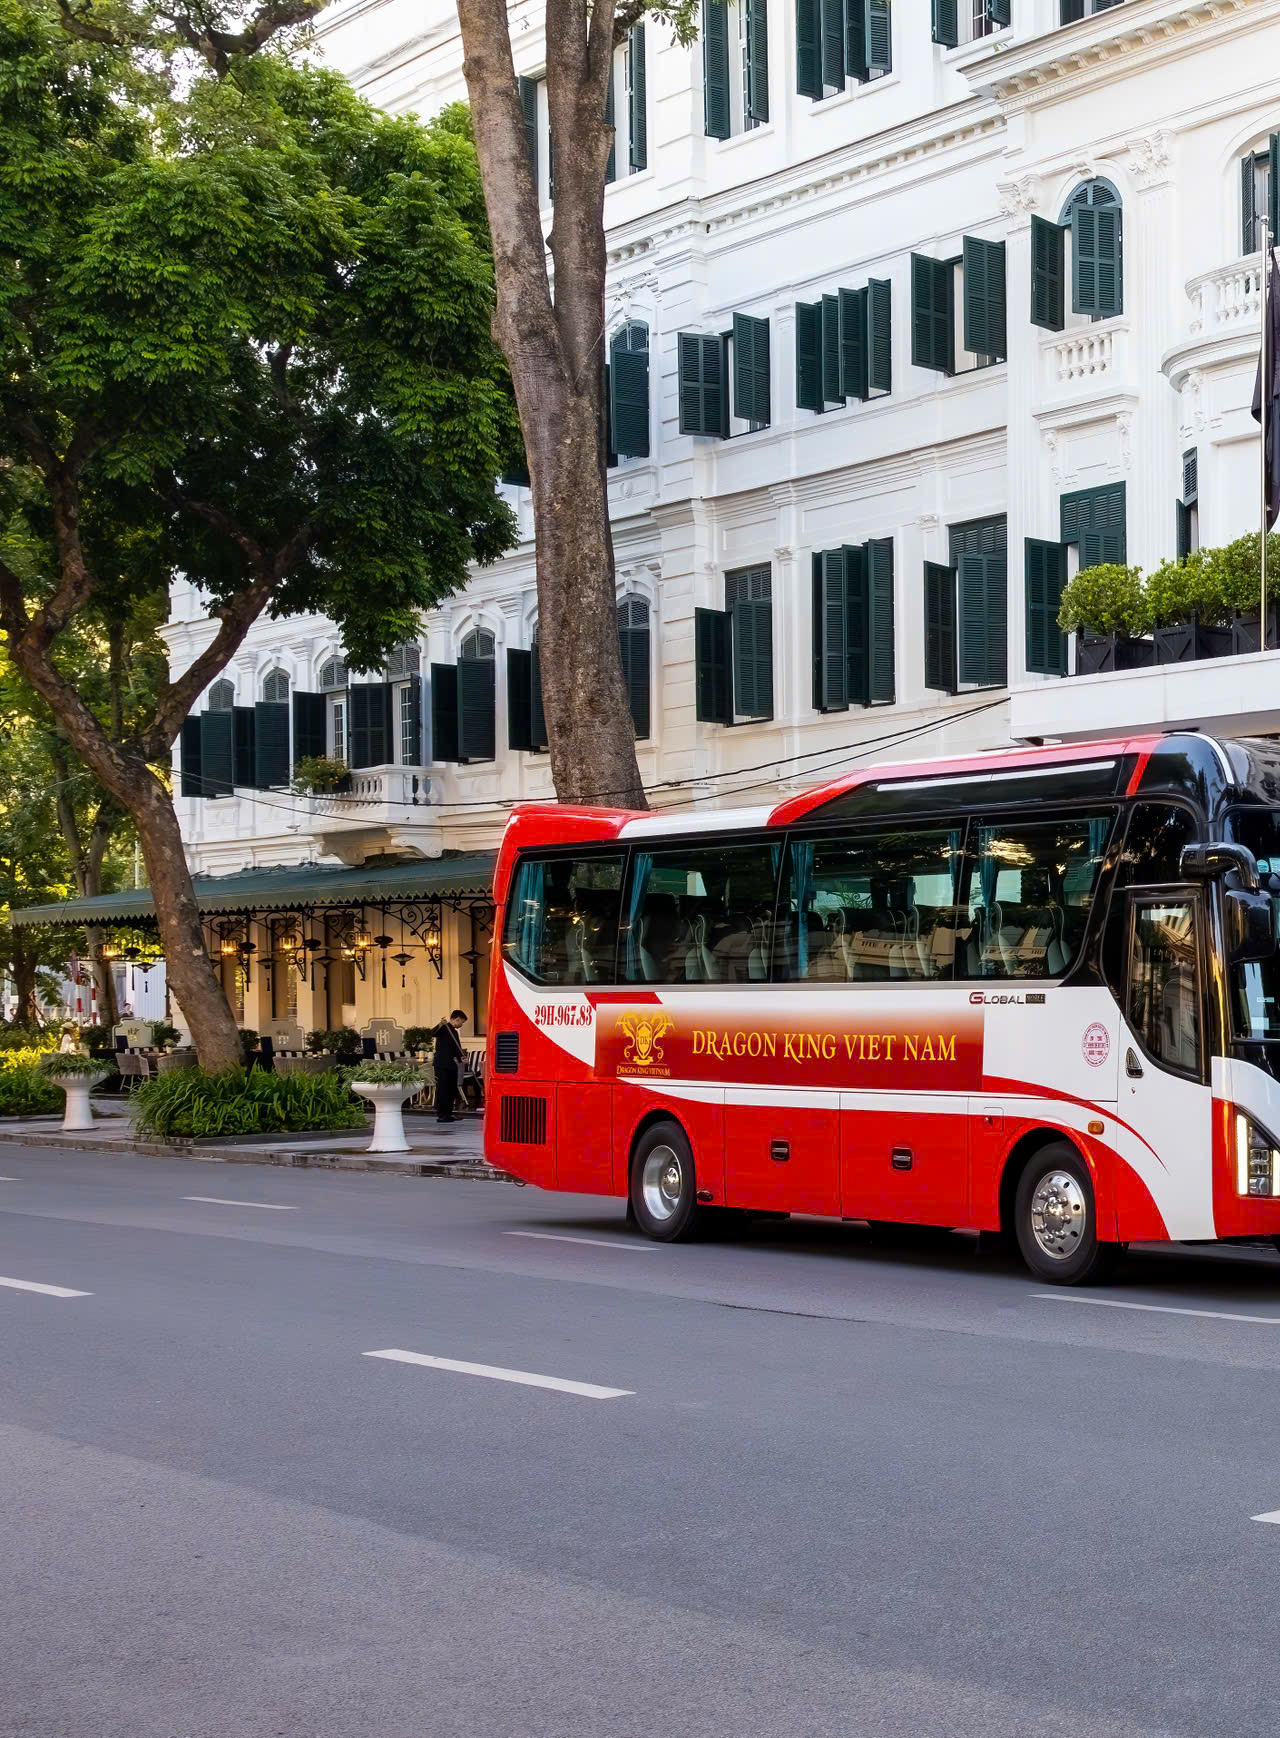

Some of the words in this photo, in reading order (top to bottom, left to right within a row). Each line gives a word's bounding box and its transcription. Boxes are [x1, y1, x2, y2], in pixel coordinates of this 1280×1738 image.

[969, 992, 1024, 1005] GLOBAL
[534, 1004, 593, 1026] 29H-967.83
[692, 1030, 777, 1061] DRAGON
[784, 1033, 836, 1064] KING
[843, 1033, 896, 1060] VIET
[903, 1034, 957, 1061] NAM
